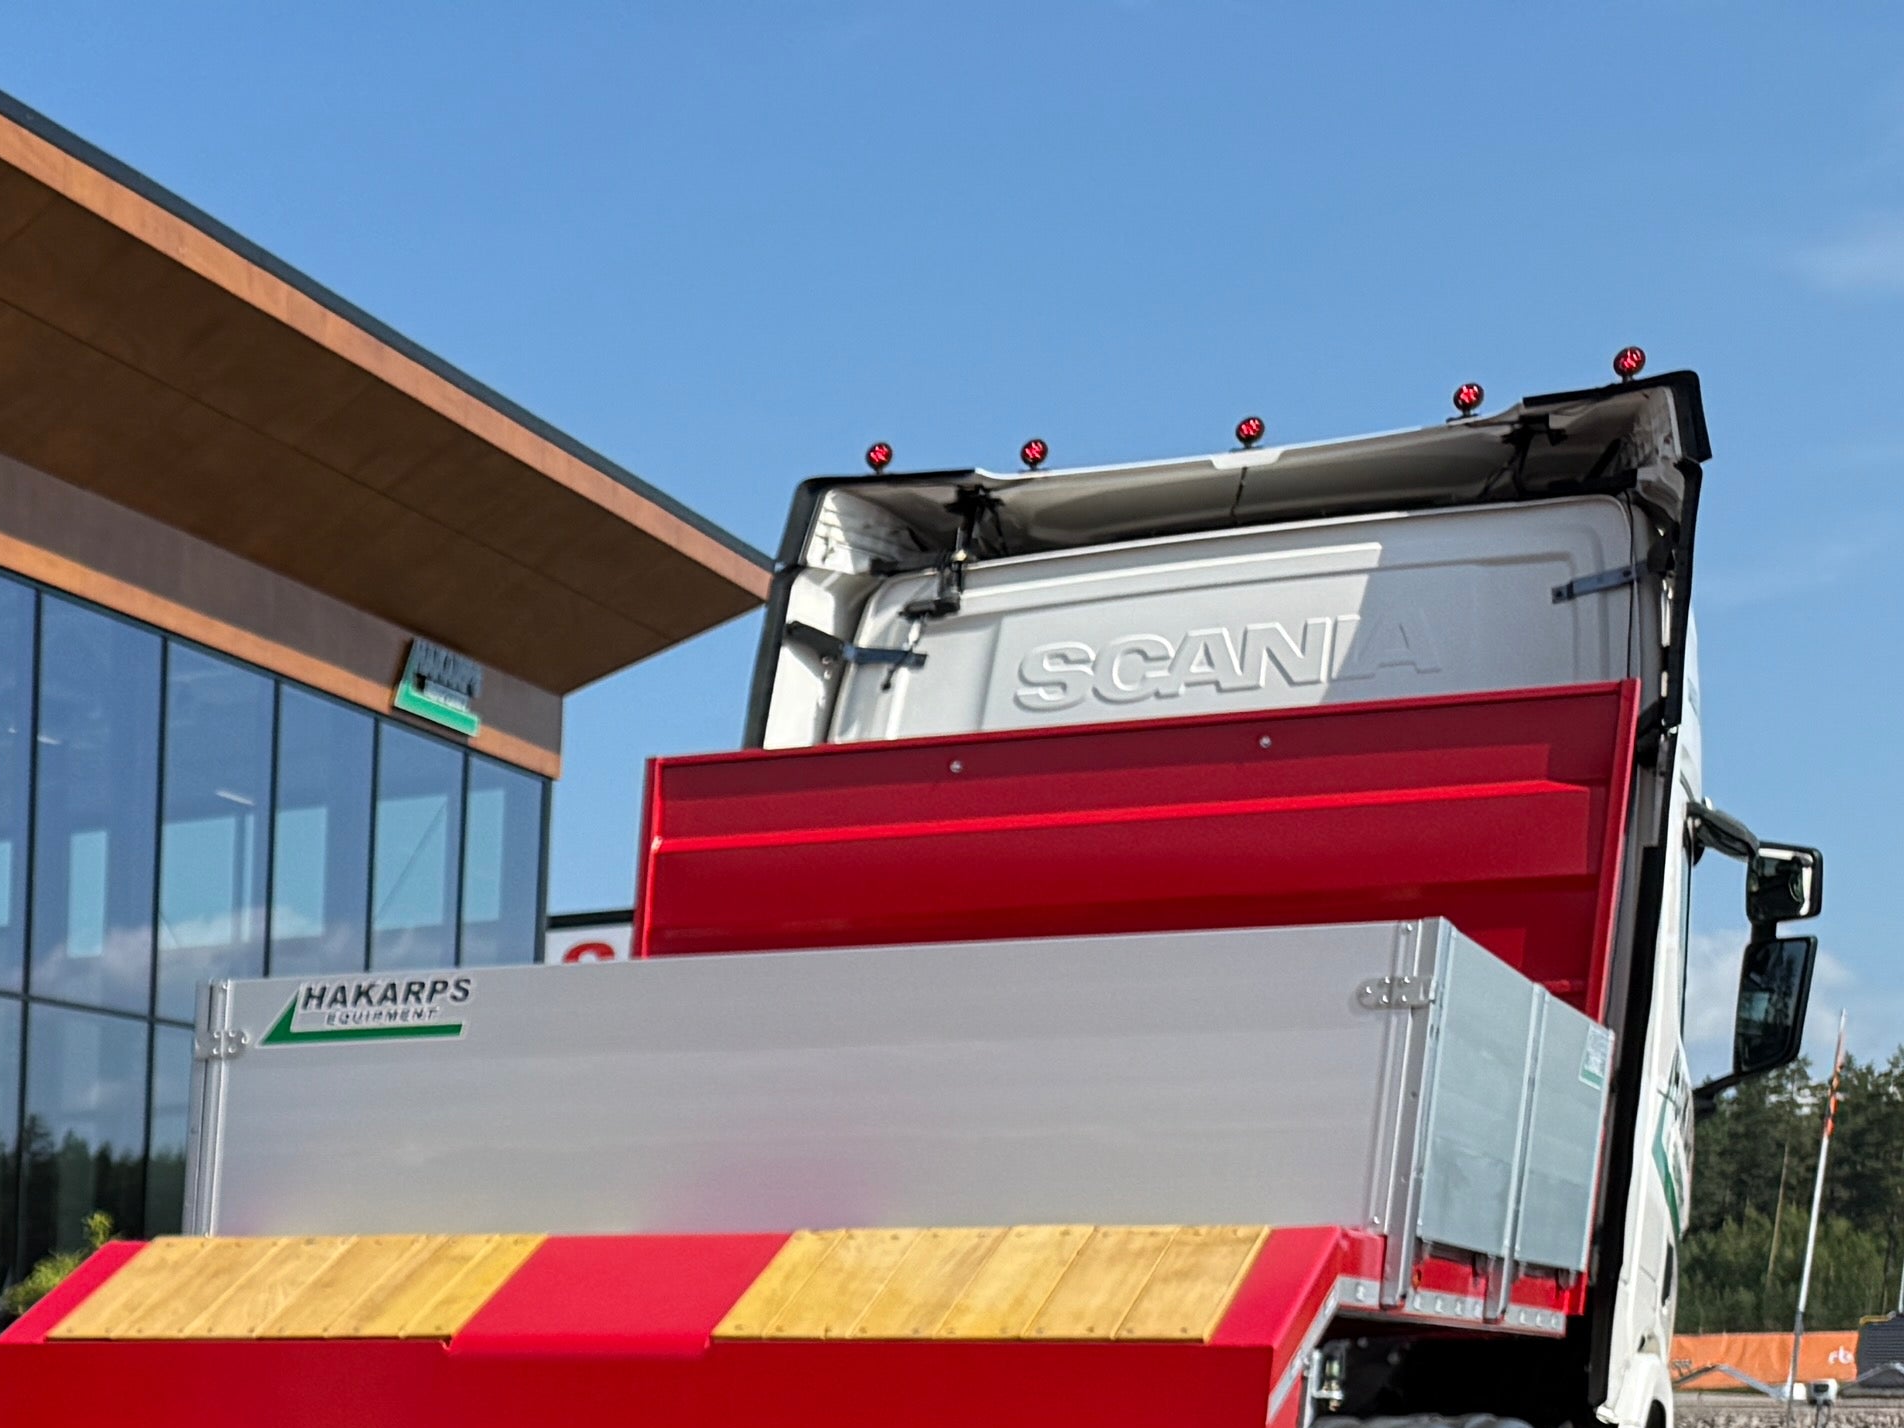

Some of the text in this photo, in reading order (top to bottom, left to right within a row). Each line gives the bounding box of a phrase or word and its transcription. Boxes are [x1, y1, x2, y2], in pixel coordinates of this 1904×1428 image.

[1014, 611, 1442, 712] SCANIA
[301, 978, 472, 1011] HAKARPS
[326, 1008, 439, 1025] EQUIPMENT
